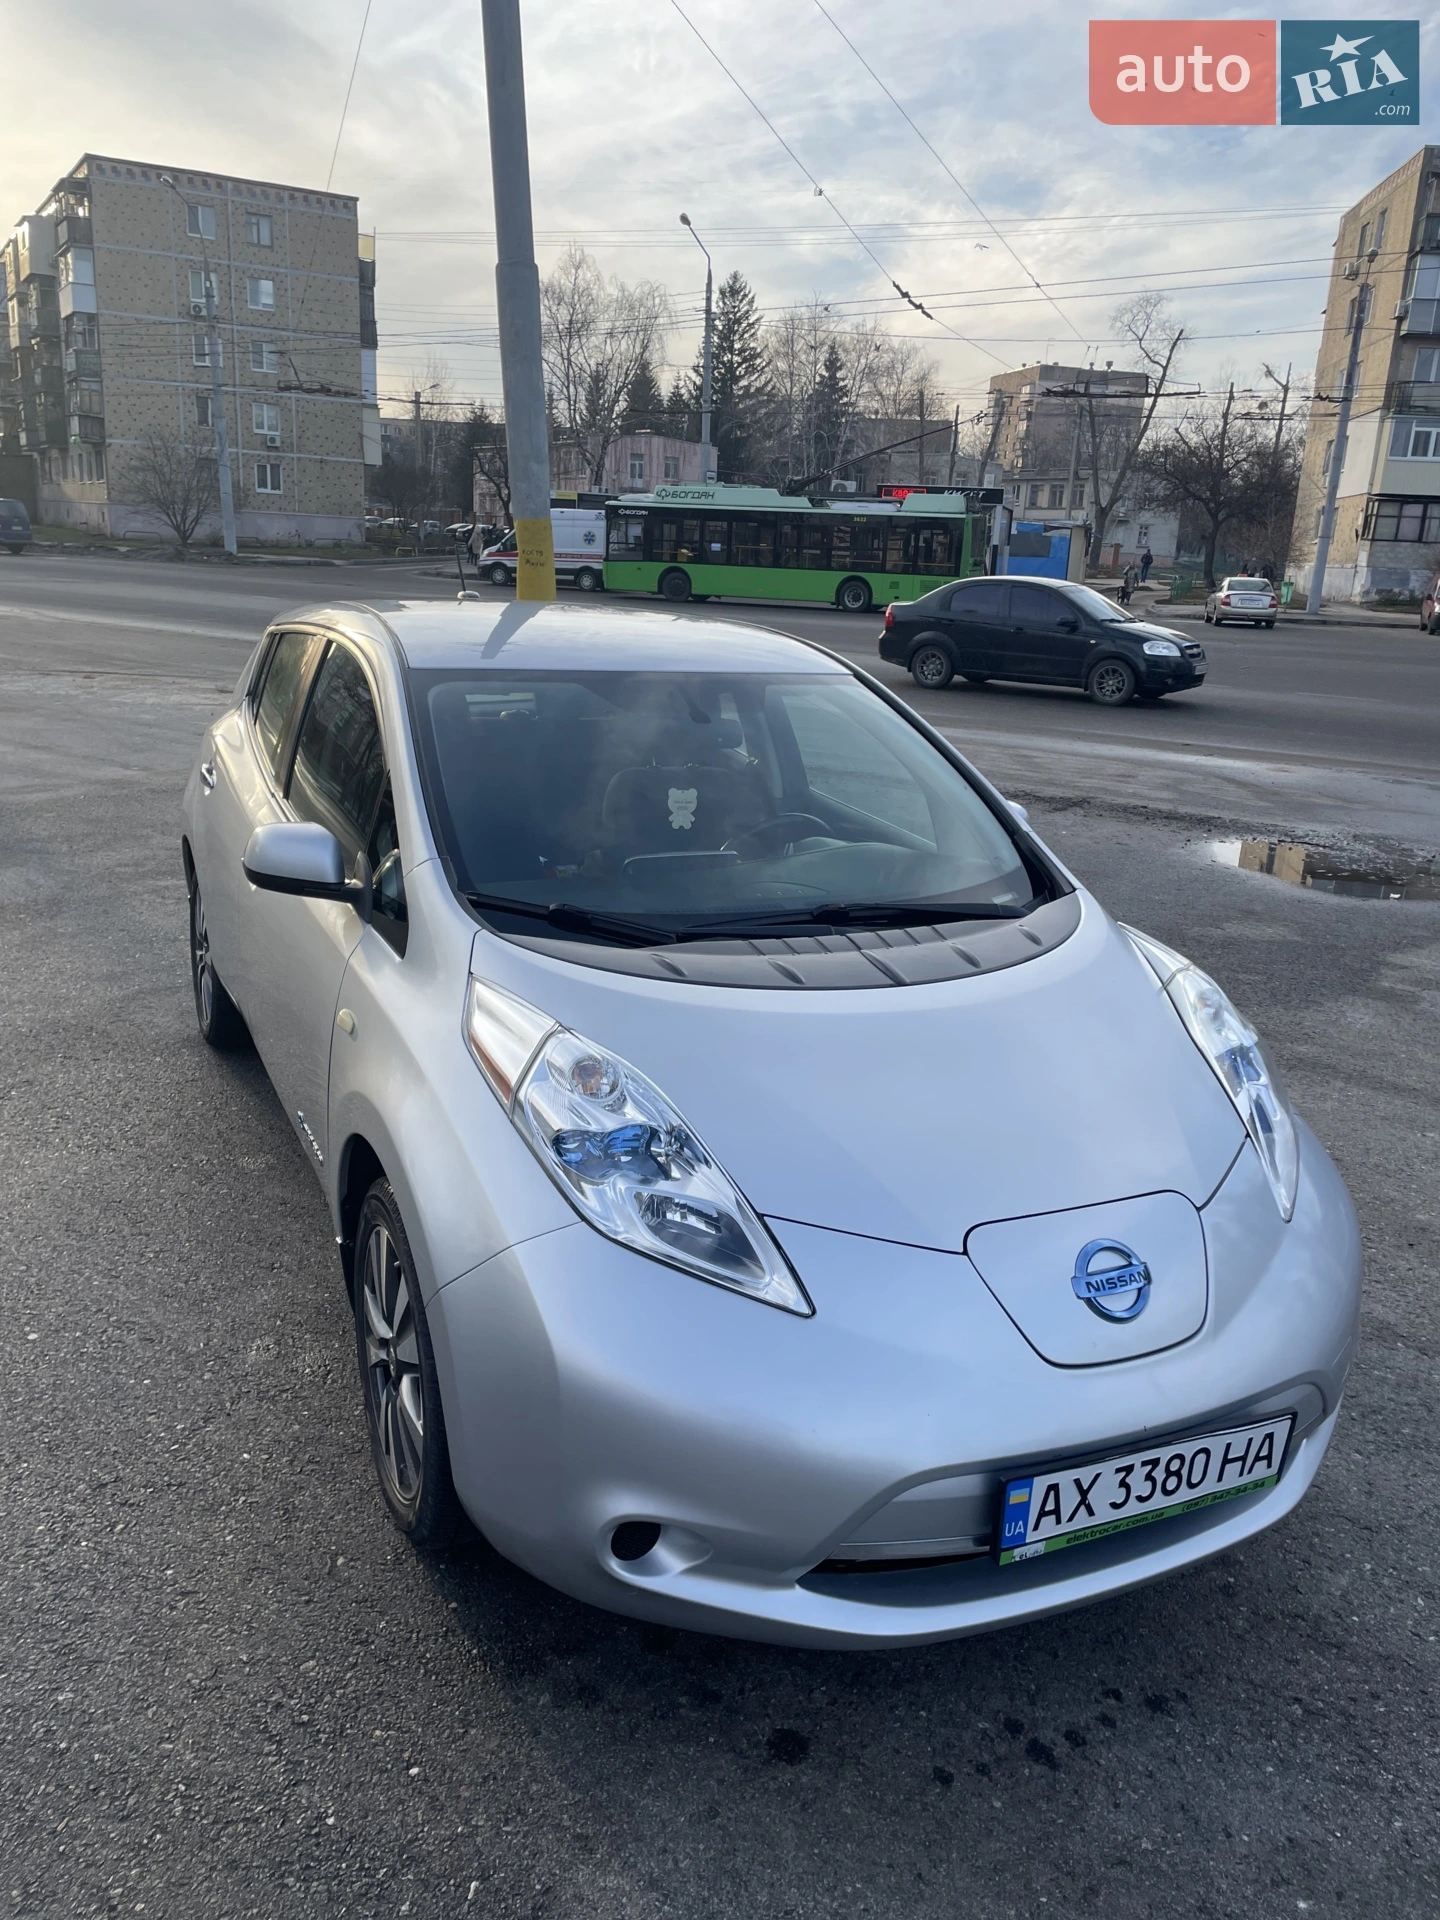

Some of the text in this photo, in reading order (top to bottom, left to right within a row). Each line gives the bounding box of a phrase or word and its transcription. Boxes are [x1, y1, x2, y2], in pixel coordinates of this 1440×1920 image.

[671, 491, 715, 499] БОГДАН
[1084, 1269, 1148, 1294] NISSAN
[1032, 1431, 1276, 1533] AX 3380 HA
[1004, 1520, 1025, 1537] UA
[1065, 1511, 1166, 1545] elektrocar.com.ua
